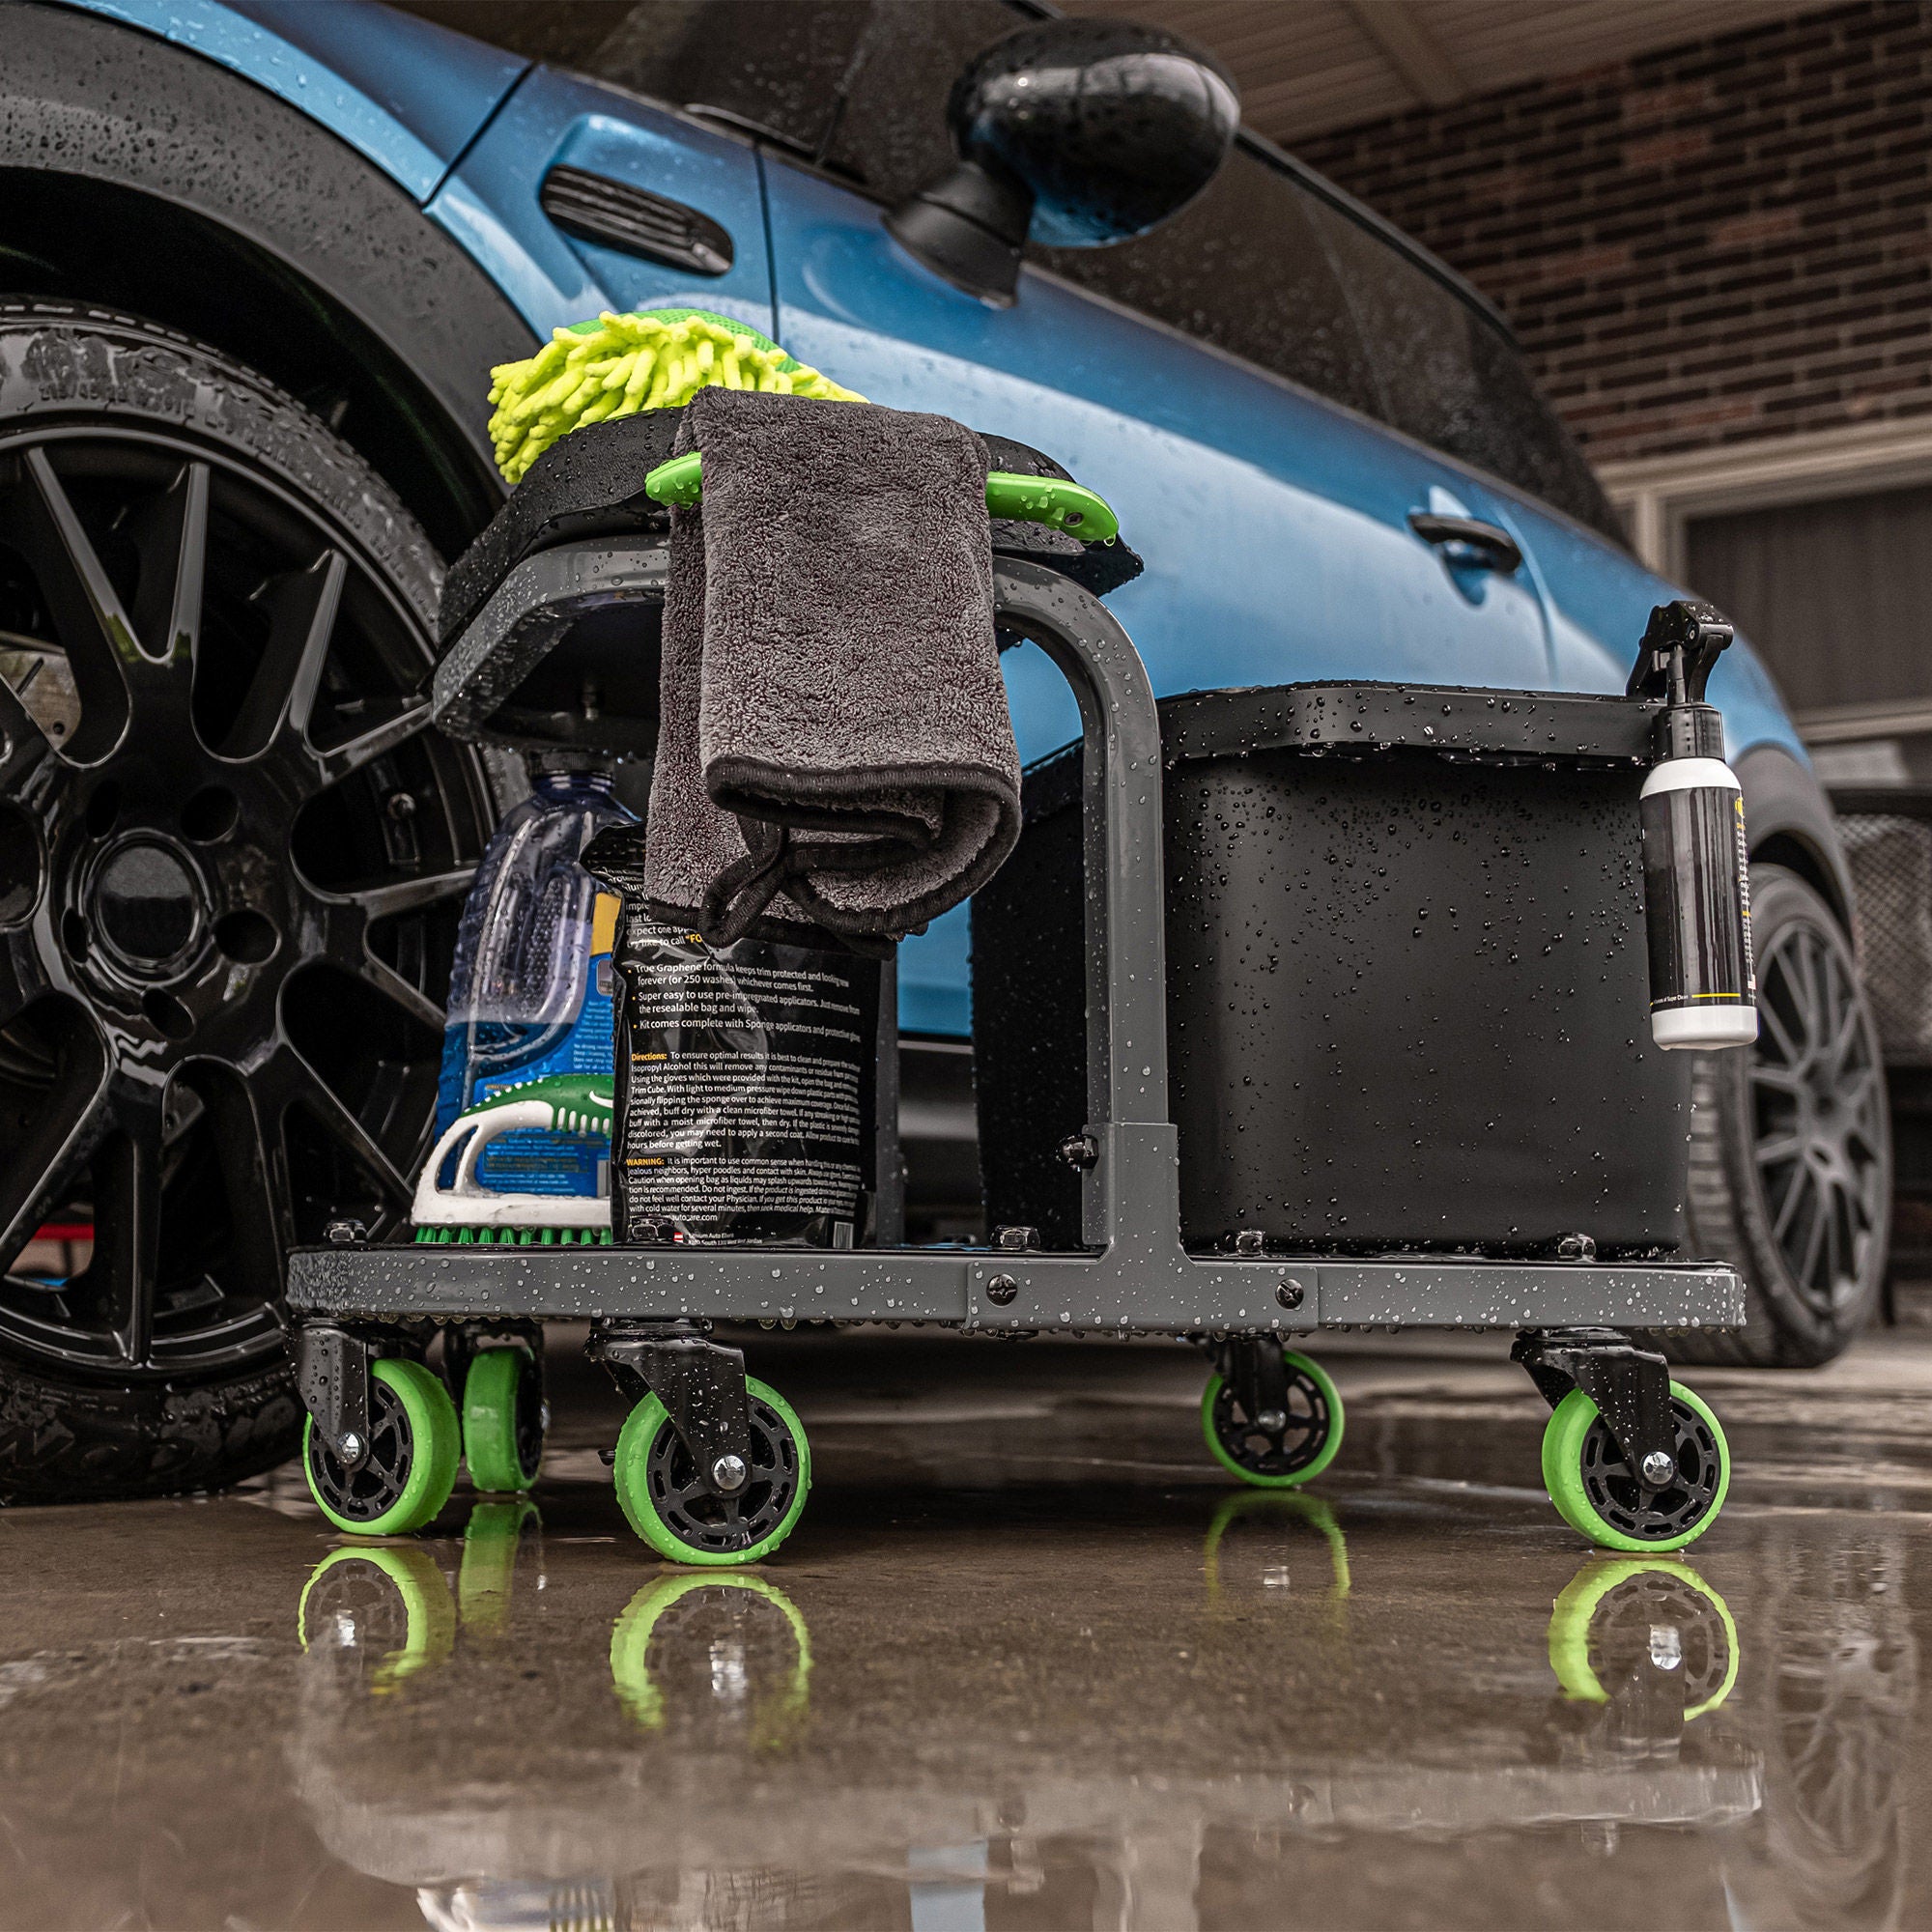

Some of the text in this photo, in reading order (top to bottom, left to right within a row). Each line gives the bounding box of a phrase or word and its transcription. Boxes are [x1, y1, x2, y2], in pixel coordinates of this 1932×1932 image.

[626, 914, 642, 923] last
[626, 926, 657, 936] expect
[670, 935, 686, 946] call
[635, 963, 821, 980] True Graphene keeps trim protected and
[638, 975, 813, 992] forever (or 250 washes) whichever comes first.
[638, 991, 662, 1002] Super
[664, 991, 684, 1001] easy
[686, 990, 696, 999] to
[715, 990, 778, 1004] pre-impregnated
[780, 995, 818, 1007] applicators.
[639, 1003, 758, 1014] the resealable bag and wipe.
[639, 1018, 824, 1035] Kit comes complete with Sponge applicators and
[632, 1053, 667, 1062] Directions:
[670, 1051, 680, 1060] To
[709, 1051, 739, 1061] optimal
[778, 1053, 789, 1062] best
[631, 1063, 662, 1073] Isopropyl
[693, 1062, 708, 1070] this
[709, 1062, 723, 1070] will
[754, 1063, 767, 1072] any
[769, 1064, 808, 1074] contaminants
[631, 1075, 650, 1084] Using
[664, 1074, 688, 1084] gloves
[688, 1073, 711, 1082] which
[732, 1073, 766, 1084] provided
[781, 1074, 791, 1083] the
[801, 1077, 814, 1086] open
[631, 1086, 646, 1094] Trim
[667, 1085, 685, 1094] With
[686, 1084, 703, 1094] light
[714, 1084, 746, 1093] medium
[746, 1086, 775, 1094] pressure
[776, 1086, 790, 1095] wipe
[630, 1096, 656, 1106] sionally
[656, 1095, 686, 1105] flipping
[701, 1095, 729, 1105] sponge
[756, 1095, 781, 1105] achieve
[630, 1108, 662, 1117] achieved,
[663, 1107, 680, 1116] buff
[681, 1107, 696, 1118] dry
[723, 1105, 743, 1114] clean
[744, 1106, 779, 1116] microfiber
[629, 1119, 642, 1127] buff
[671, 1118, 694, 1126] moist
[696, 1117, 736, 1125] microfiber
[738, 1118, 760, 1126] towel,
[779, 1119, 791, 1129] dry.
[799, 1120, 809, 1128] the
[628, 1129, 668, 1139] discolored,
[670, 1130, 685, 1139] you
[687, 1129, 704, 1138] may
[737, 1128, 757, 1139] apply
[765, 1129, 788, 1138] second
[627, 1139, 722, 1150] hours before getting wet.
[626, 1157, 665, 1166] WARNING:
[681, 1156, 718, 1166] important
[627, 1167, 653, 1177] jealous
[653, 1167, 690, 1177] neighbors,
[691, 1166, 712, 1176] hyper
[713, 1166, 741, 1175] poodles
[675, 1176, 704, 1184] opening
[706, 1176, 720, 1185] bag
[730, 1176, 752, 1184] liquids
[767, 1177, 786, 1185] splash
[787, 1177, 812, 1186] upwards
[726, 1185, 749, 1195] ingest.
[764, 1186, 787, 1195] product
[708, 1196, 724, 1205] your
[726, 1195, 758, 1205] Physician.
[775, 1196, 785, 1205] get
[798, 1197, 823, 1206] product
[718, 1205, 747, 1213] minutes,
[799, 1205, 814, 1214] help.
